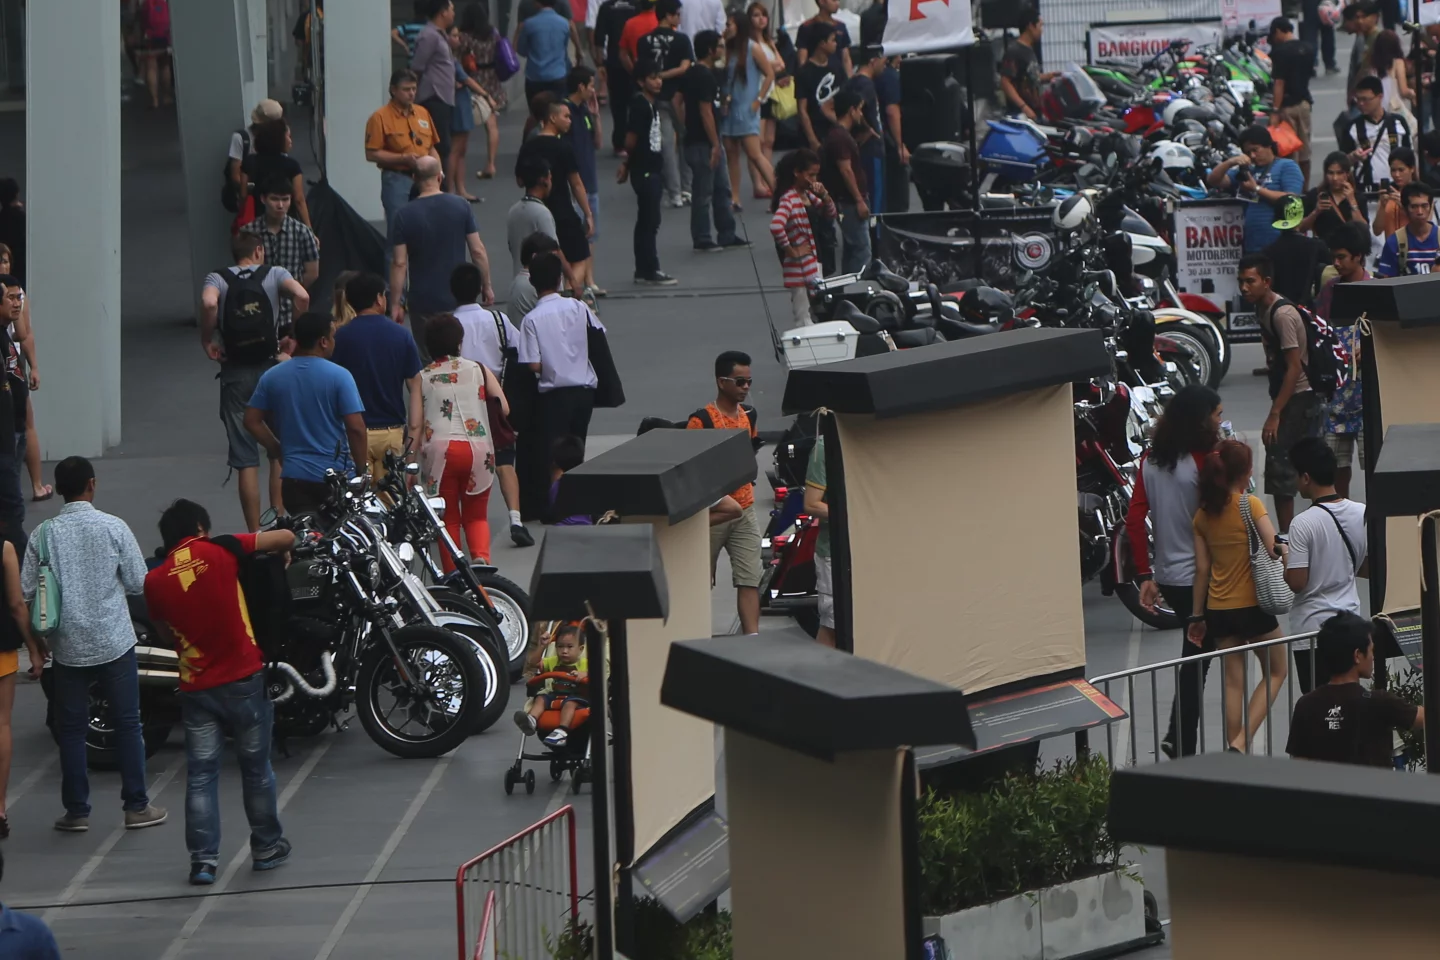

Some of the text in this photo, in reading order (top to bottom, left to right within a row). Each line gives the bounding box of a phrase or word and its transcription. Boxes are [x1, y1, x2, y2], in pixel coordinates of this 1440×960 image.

[1185, 225, 1243, 249] BANG
[1186, 248, 1240, 261] MOTORBIKE
[1187, 266, 1236, 276] 30 JAN 3 FEB
[1414, 262, 1431, 275] 10
